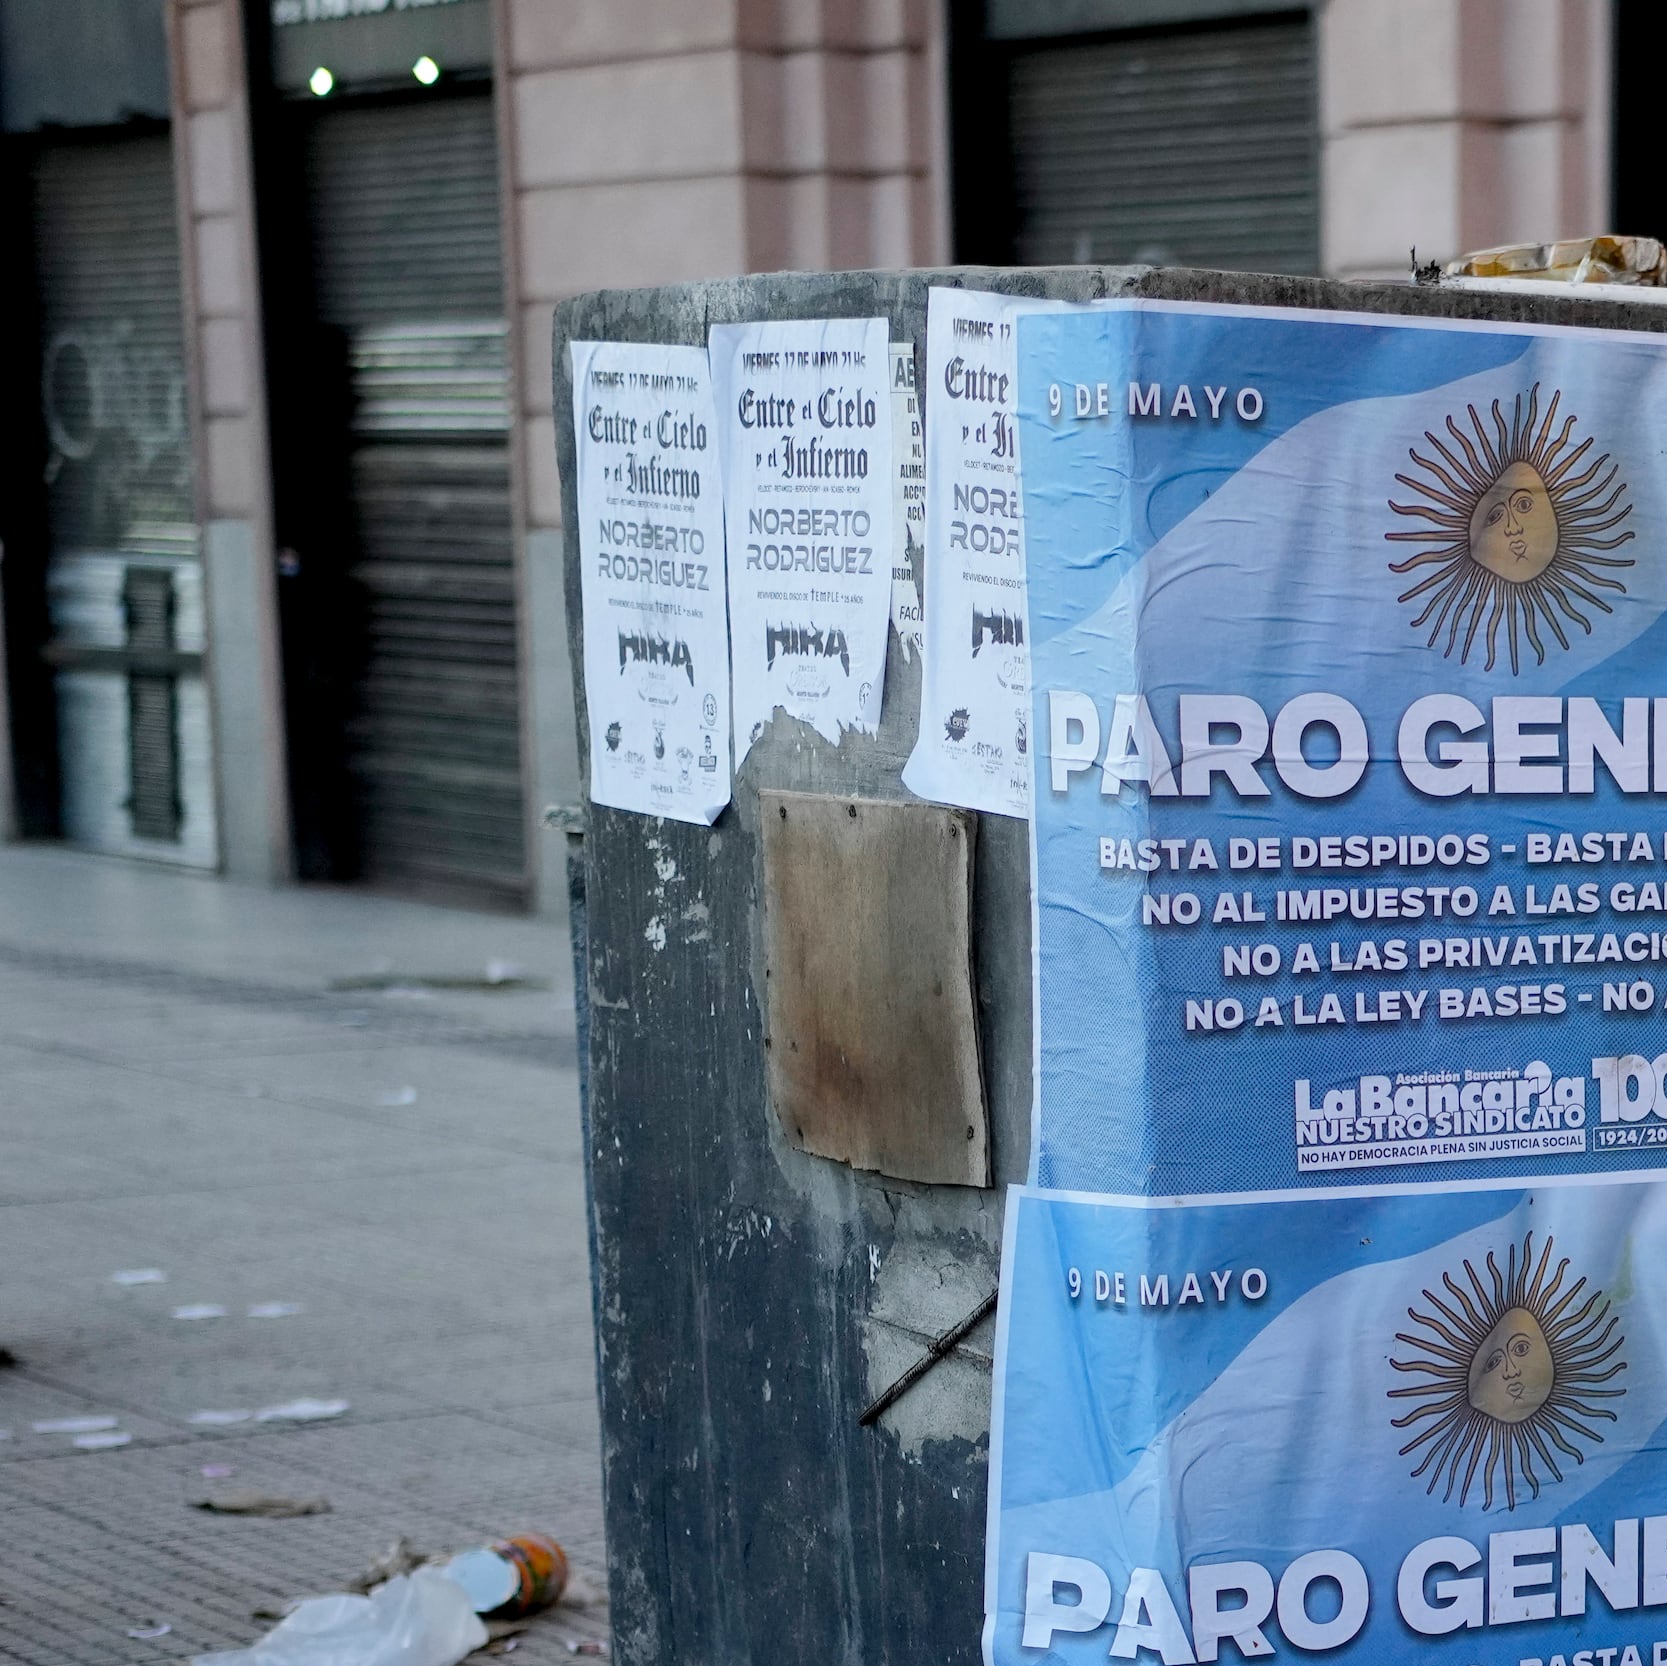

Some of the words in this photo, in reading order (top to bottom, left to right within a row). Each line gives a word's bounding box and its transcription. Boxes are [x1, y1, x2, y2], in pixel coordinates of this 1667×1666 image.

[945, 356, 1009, 405] Entre
[738, 388, 795, 428] Entre
[802, 400, 812, 420] el
[818, 386, 876, 428] Cielo
[1049, 385, 1062, 416] 9
[1075, 385, 1109, 417] DE
[1127, 383, 1265, 422] MAYO
[589, 404, 637, 445] Entre
[643, 421, 652, 439] el
[657, 410, 707, 451] Cielo
[962, 425, 969, 445] y
[976, 423, 987, 443] el
[615, 464, 622, 482] el
[626, 452, 700, 499] Infierno
[756, 452, 762, 471] y
[768, 448, 777, 467] el
[781, 435, 868, 479] Infierno
[600, 519, 705, 555] NORBERTO
[748, 508, 871, 537] NORBERTO
[962, 571, 993, 585] REVIVIENDO
[993, 577, 999, 586] EL
[1000, 577, 1016, 588] DISCO
[1049, 690, 1369, 798] PARO
[1099, 836, 1215, 871] BASTA
[1230, 838, 1281, 869] DE
[1292, 836, 1489, 869] DESPIDOS
[1526, 832, 1653, 865] BASTA
[1143, 892, 1201, 925] NO
[1212, 891, 1266, 924] AL
[1276, 886, 1477, 921] IMPUESTO
[1488, 885, 1514, 916] A
[1526, 882, 1600, 915] LAS
[1223, 943, 1281, 976] NO
[1292, 943, 1321, 974] A
[1330, 939, 1408, 972] LAS
[1185, 997, 1244, 1031] NO
[1256, 996, 1285, 1027] A
[1294, 993, 1345, 1025] LA
[1354, 989, 1427, 1025] LEY
[1440, 984, 1566, 1020] BASES
[1602, 980, 1655, 1012] NO
[1396, 1072, 1460, 1084] Asociación
[1464, 1068, 1519, 1081] Bancaria
[1297, 1113, 1428, 1145] NUESTRO
[1435, 1105, 1585, 1137] SINDICATO
[1301, 1152, 1321, 1163] NO
[1323, 1151, 1347, 1162] HAY
[1349, 1146, 1428, 1161] DEMOCRACIA
[1430, 1143, 1465, 1155] PLENA
[1468, 1141, 1487, 1154] SIN
[1489, 1138, 1539, 1151] JUSTICIA
[1542, 1135, 1583, 1149] SOCIAL
[1068, 1268, 1081, 1299] 9
[1095, 1271, 1125, 1303] DE
[1140, 1268, 1268, 1307] MAYO
[1022, 1549, 1370, 1666] PARO
